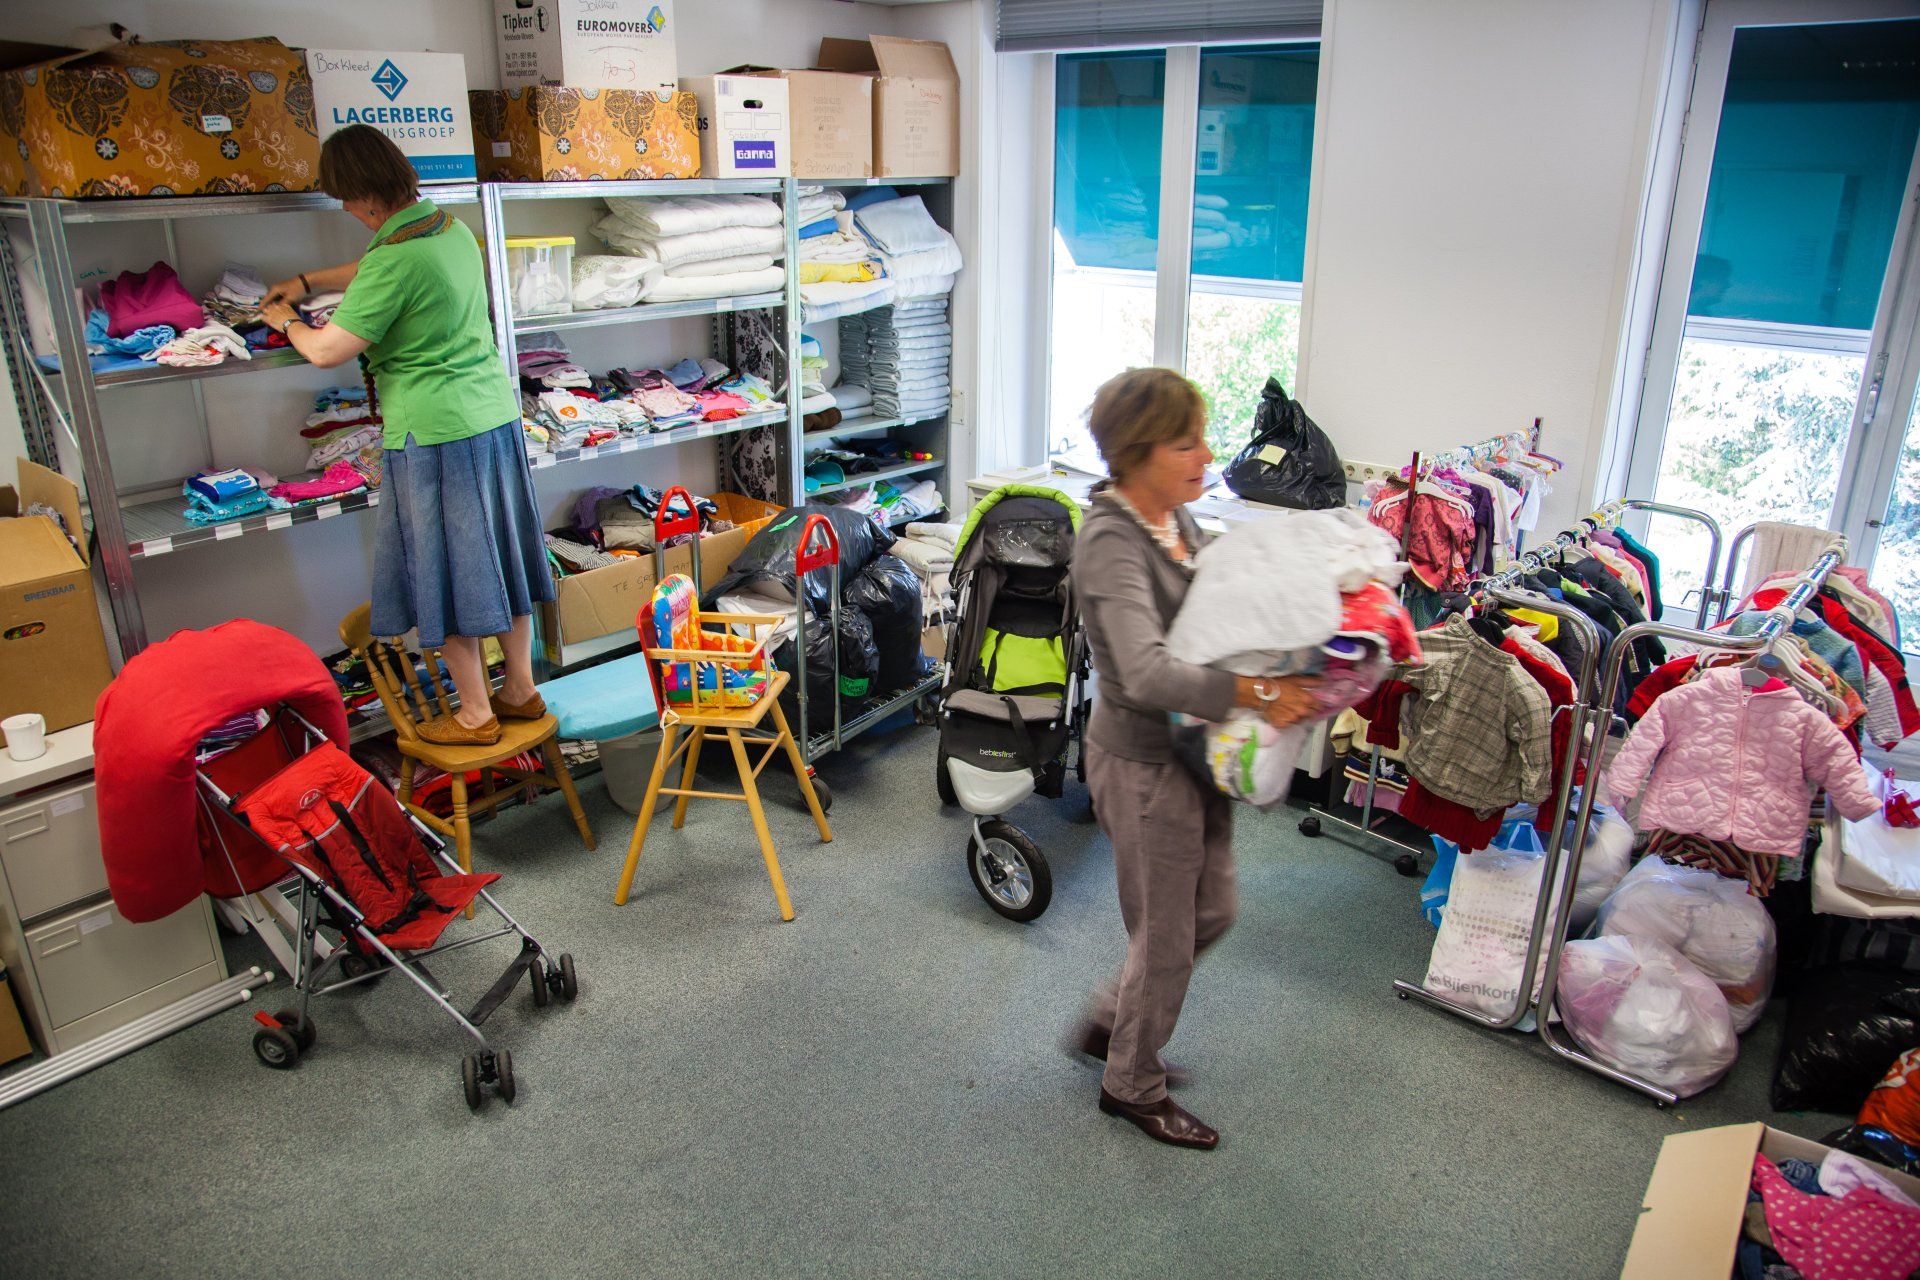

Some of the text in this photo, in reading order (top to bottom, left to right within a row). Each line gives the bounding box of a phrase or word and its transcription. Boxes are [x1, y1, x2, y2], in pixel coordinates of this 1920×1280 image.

[503, 13, 533, 32] Tipker
[577, 20, 653, 34] EUROMOVERS
[332, 107, 454, 124] LAGERBERG
[612, 582, 629, 593] TE
[1442, 974, 1517, 1001] Bijenkorf
